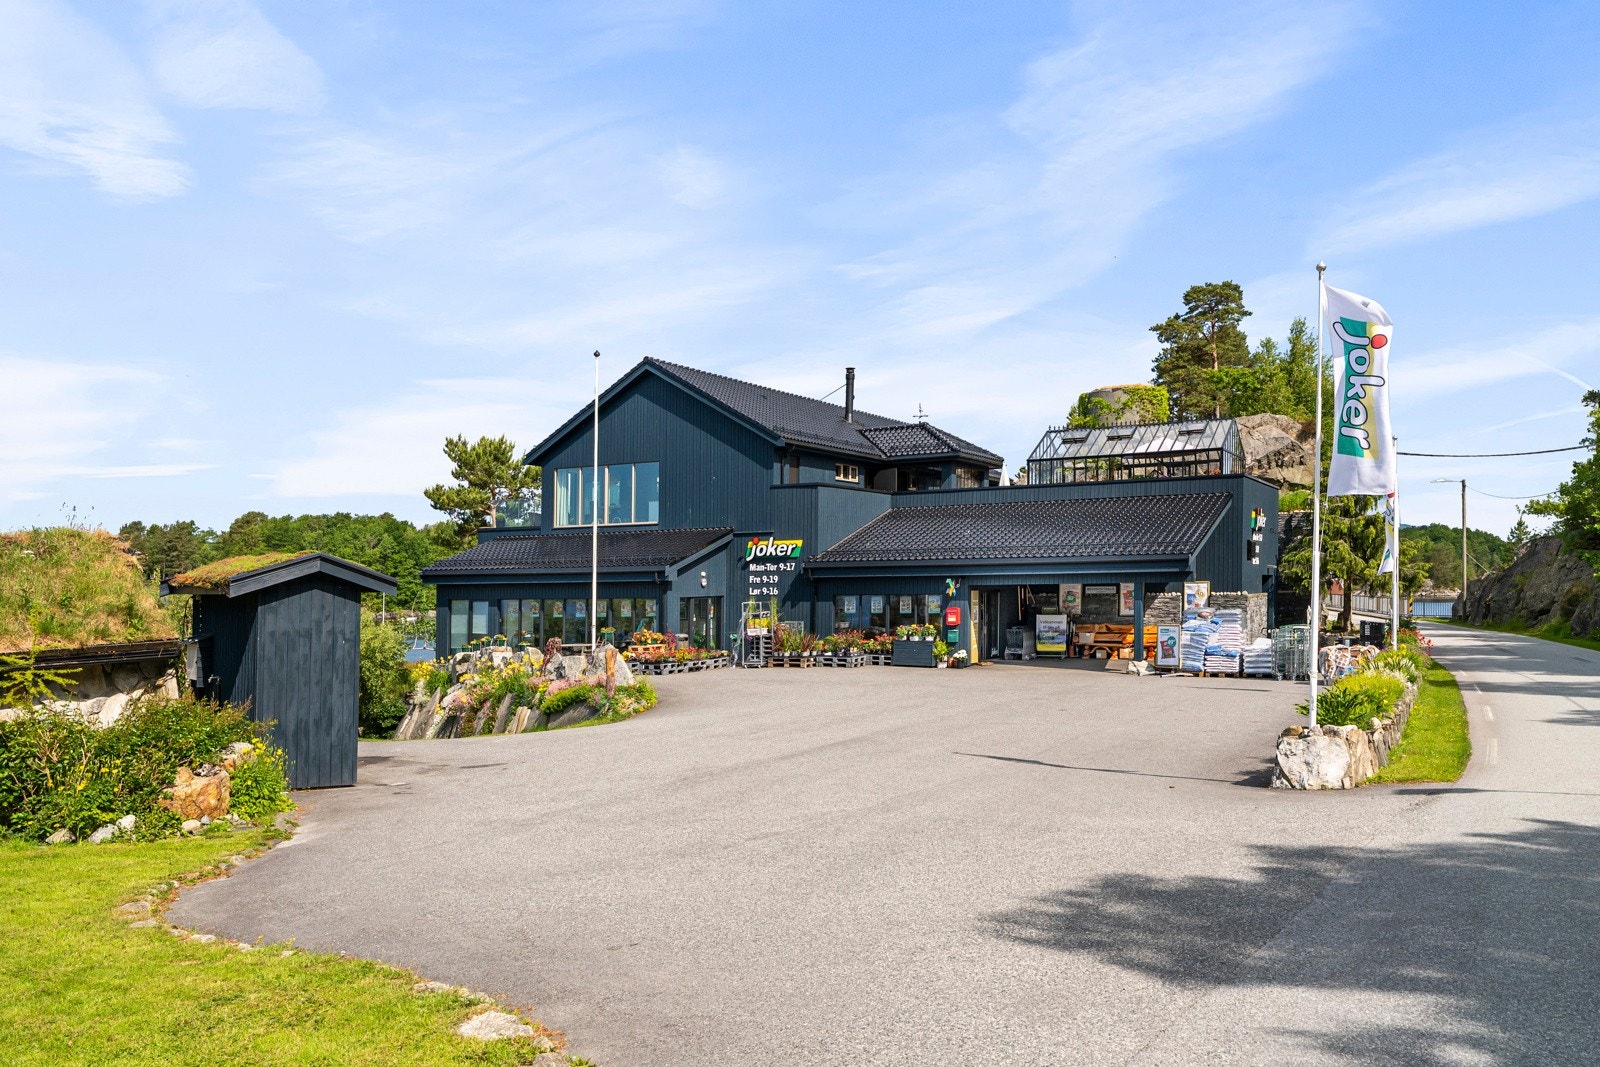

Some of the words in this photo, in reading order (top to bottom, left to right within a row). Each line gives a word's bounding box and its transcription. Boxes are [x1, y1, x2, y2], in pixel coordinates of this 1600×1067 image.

[1333, 321, 1388, 450] joker
[746, 536, 797, 561] joker
[749, 563, 777, 571] Man-Tor
[779, 563, 795, 571] 9-17
[749, 575, 760, 583] Fre
[762, 575, 778, 583] 9-19
[749, 587, 761, 595] Lør
[762, 587, 778, 595] 9-16
